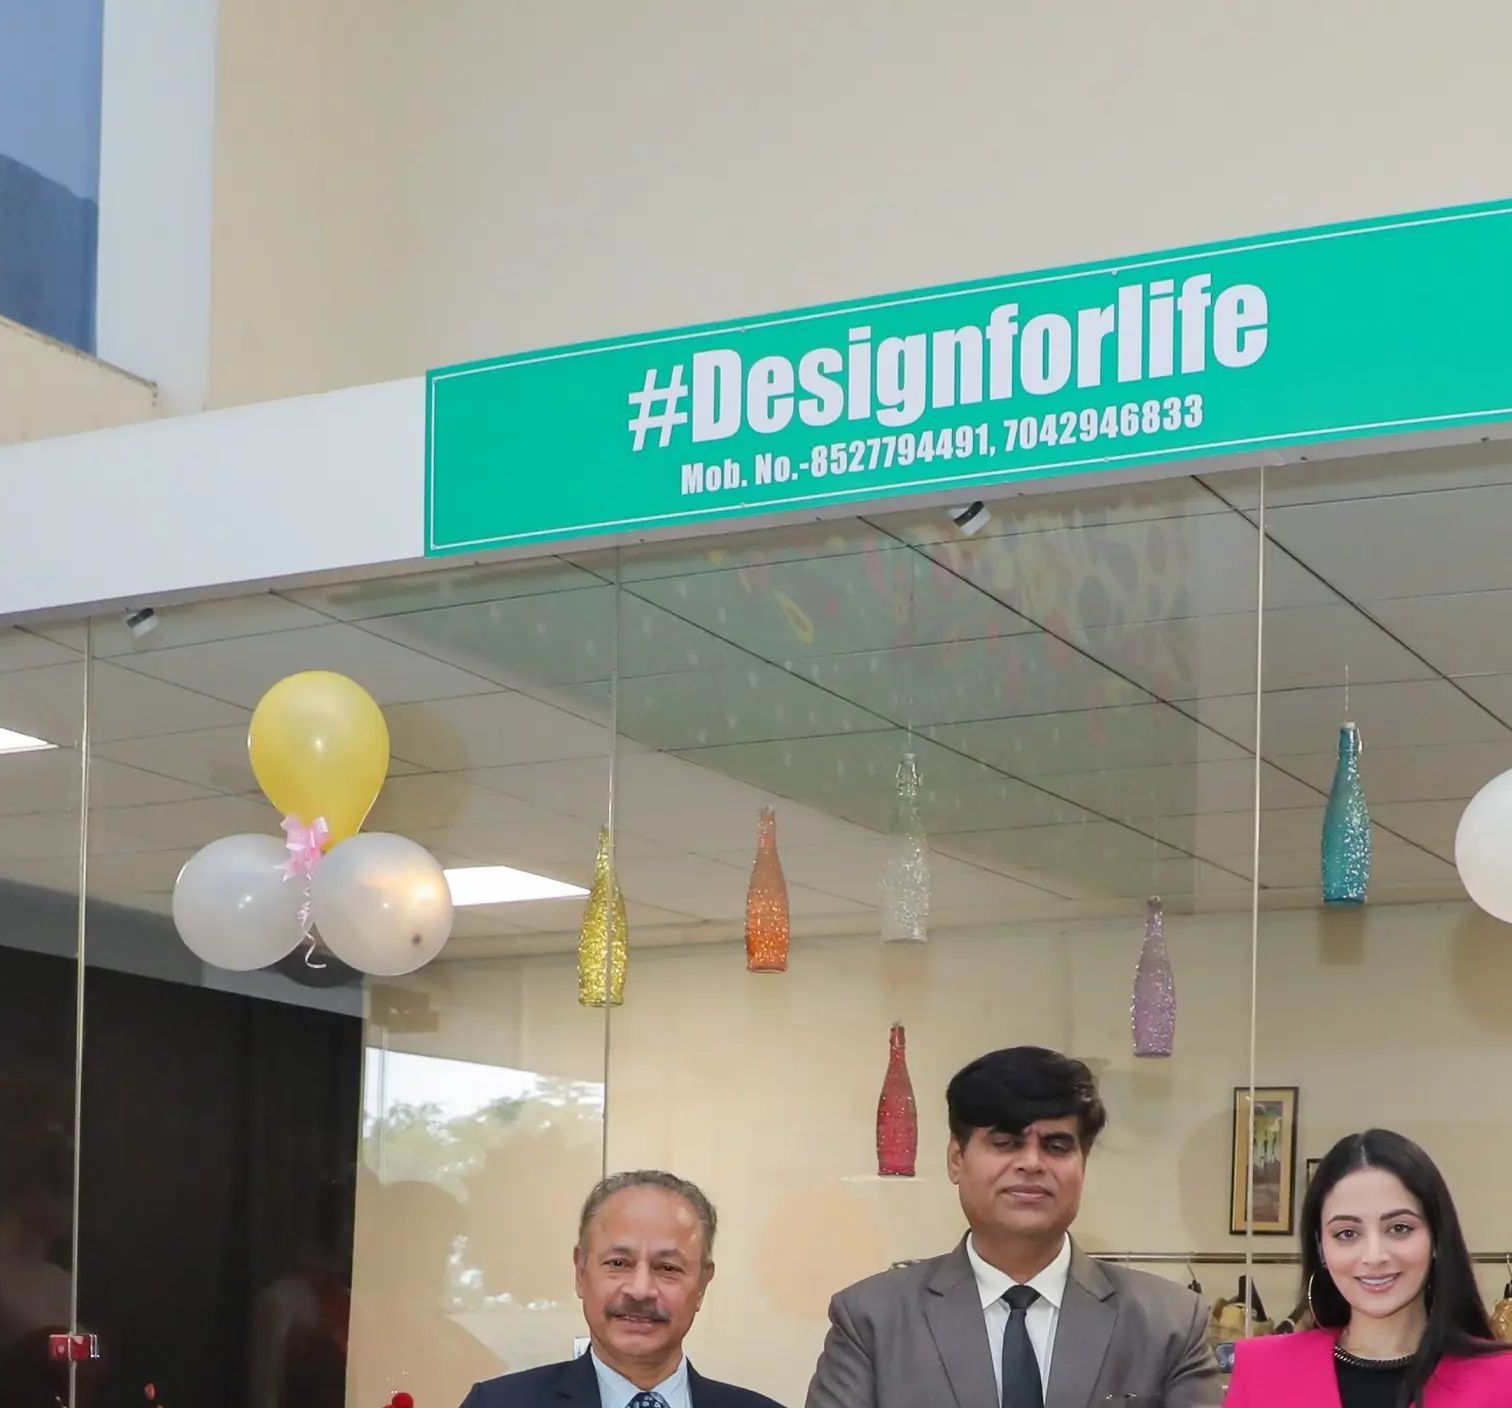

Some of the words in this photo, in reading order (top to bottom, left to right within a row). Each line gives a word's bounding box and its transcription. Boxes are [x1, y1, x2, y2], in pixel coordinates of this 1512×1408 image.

[629, 274, 1267, 450] #Designforlife
[682, 459, 747, 495] Mob.
[755, 423, 996, 485] No.-8527794491,
[1003, 394, 1203, 452] 7042946833
